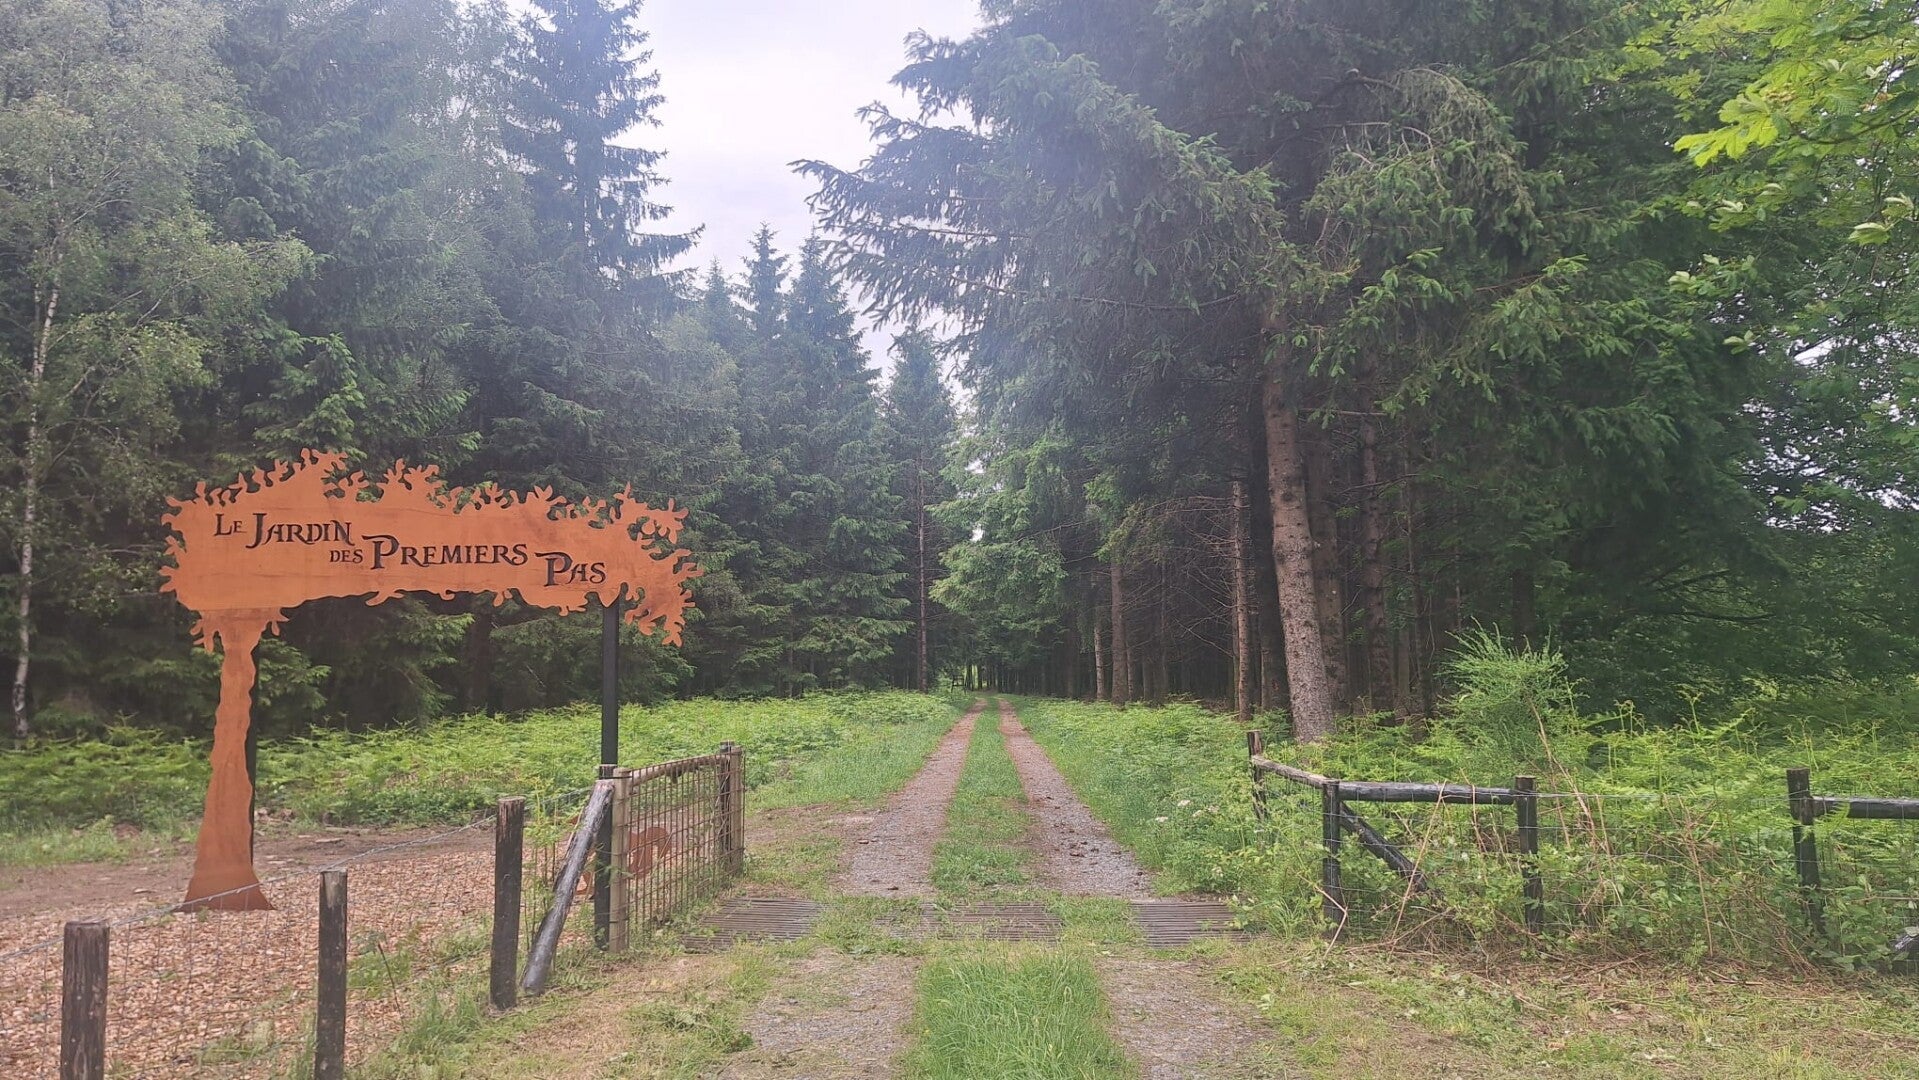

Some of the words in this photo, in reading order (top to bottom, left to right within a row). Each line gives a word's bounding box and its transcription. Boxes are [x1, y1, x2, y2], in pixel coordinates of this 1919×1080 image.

[213, 513, 247, 537] LE
[245, 512, 355, 549] JARDIN
[329, 549, 363, 563] DES
[361, 534, 528, 570] PREMIERS
[534, 551, 606, 588] PAS
